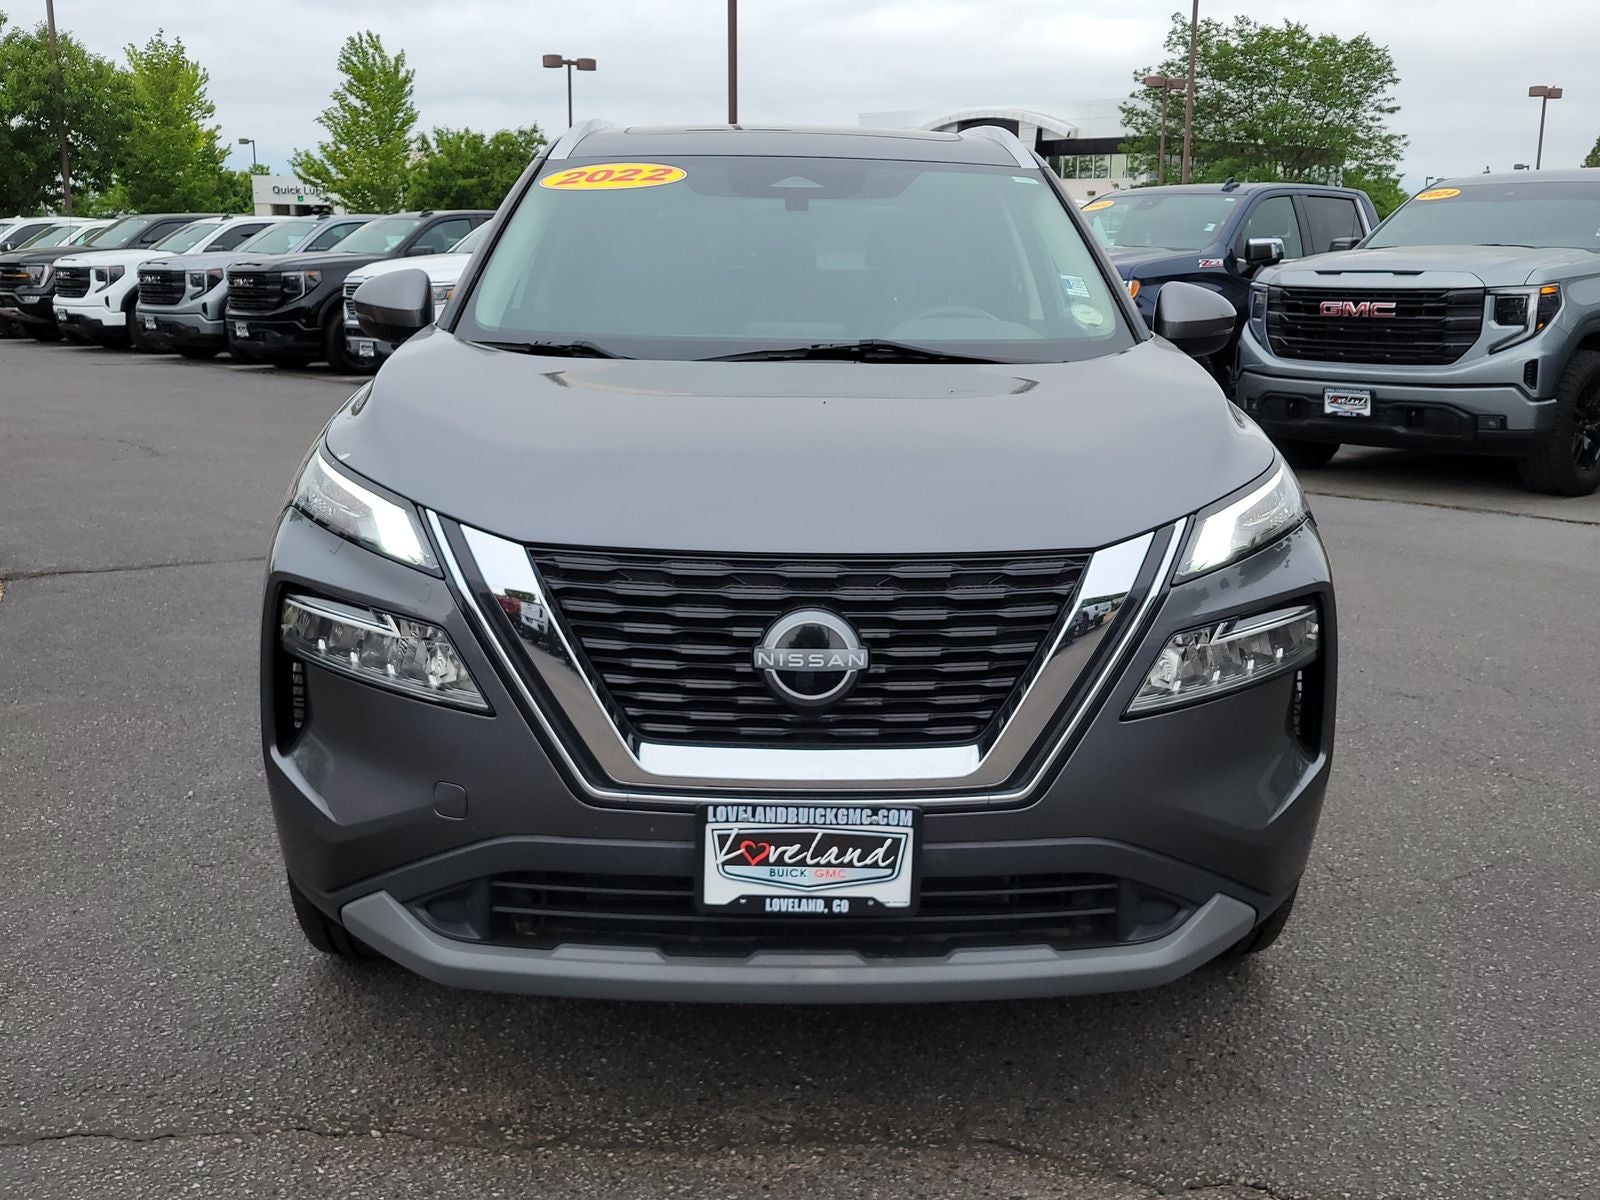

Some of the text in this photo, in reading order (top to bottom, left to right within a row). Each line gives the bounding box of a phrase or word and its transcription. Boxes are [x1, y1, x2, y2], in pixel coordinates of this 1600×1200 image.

[555, 168, 673, 185] 2022
[272, 185, 301, 195] Quick
[1319, 301, 1397, 318] GMC
[757, 652, 865, 667] NISSAN
[707, 805, 913, 826] LOVELANDBUICKGMC.COM
[769, 868, 848, 879] BUICK GMC
[765, 898, 850, 914] LOVELAND, CO
